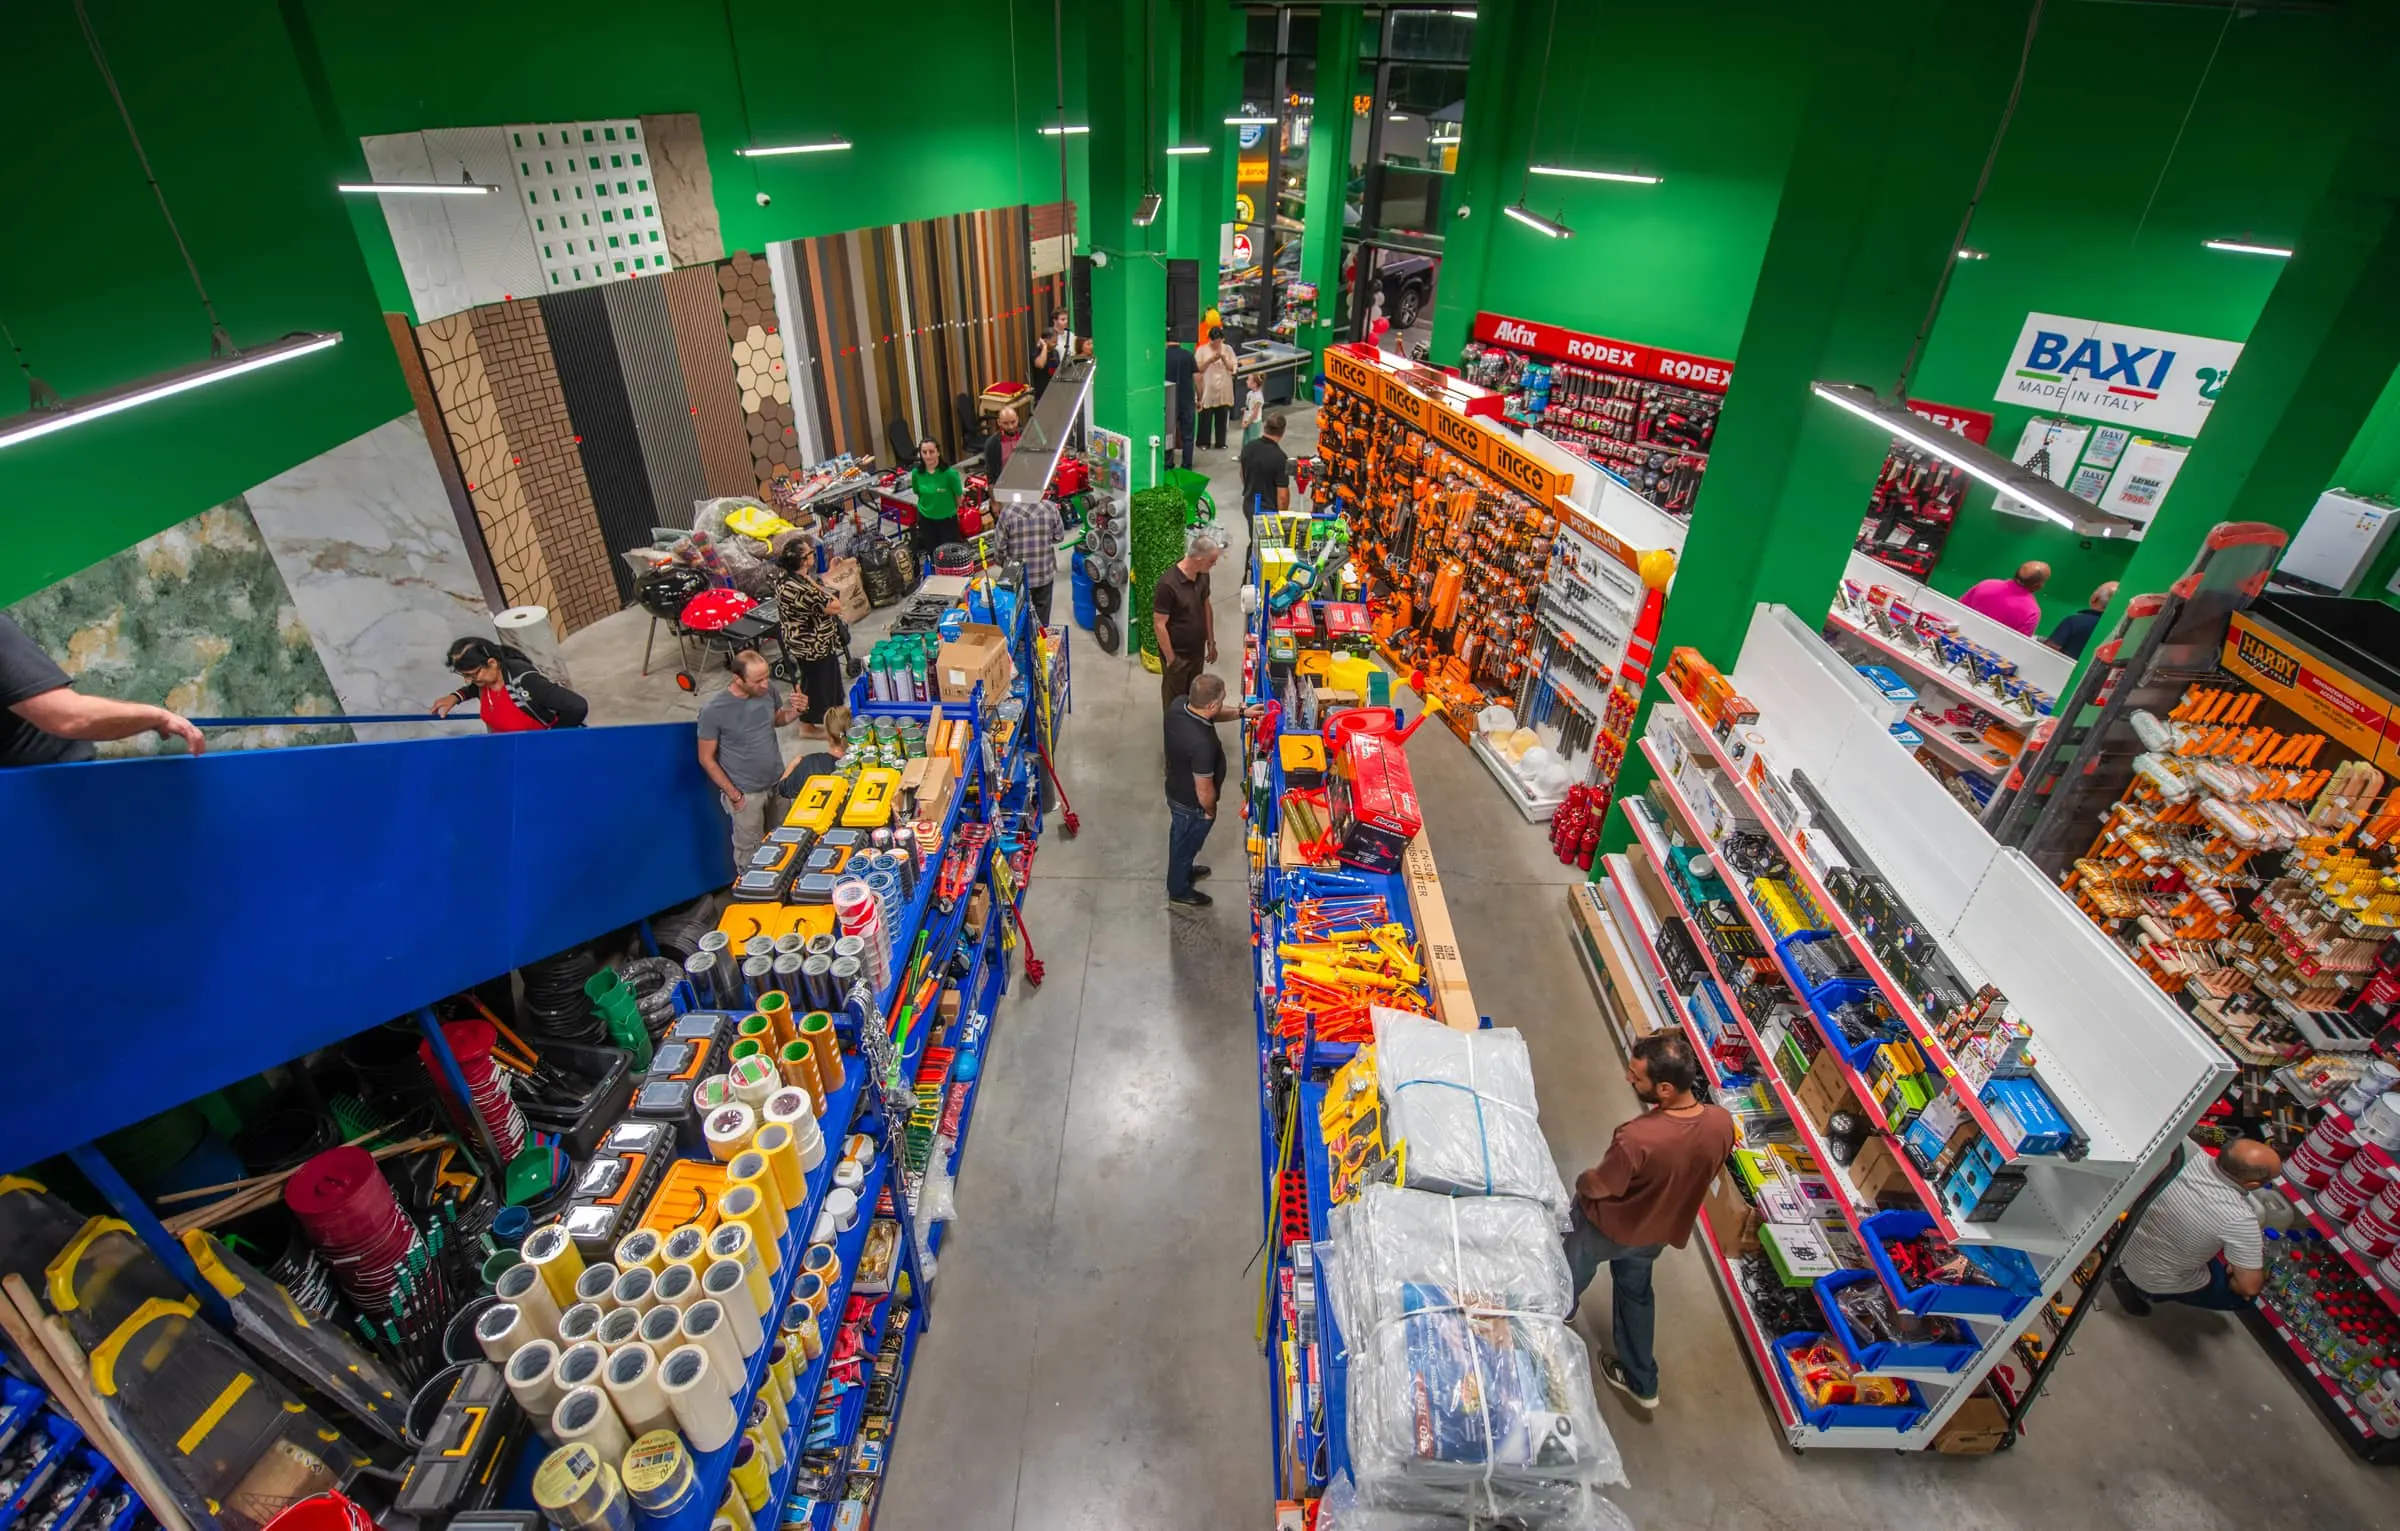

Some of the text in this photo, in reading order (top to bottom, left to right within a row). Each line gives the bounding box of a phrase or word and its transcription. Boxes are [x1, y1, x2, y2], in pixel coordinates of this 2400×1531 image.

[1494, 320, 1537, 348] Akfix
[1567, 340, 1636, 368] RODEX
[2025, 331, 2176, 391] BAXI
[2018, 380, 2145, 413] MADE IN ITALY
[1569, 514, 1621, 553] PROJAHN
[1413, 864, 1428, 897] CUTTER
